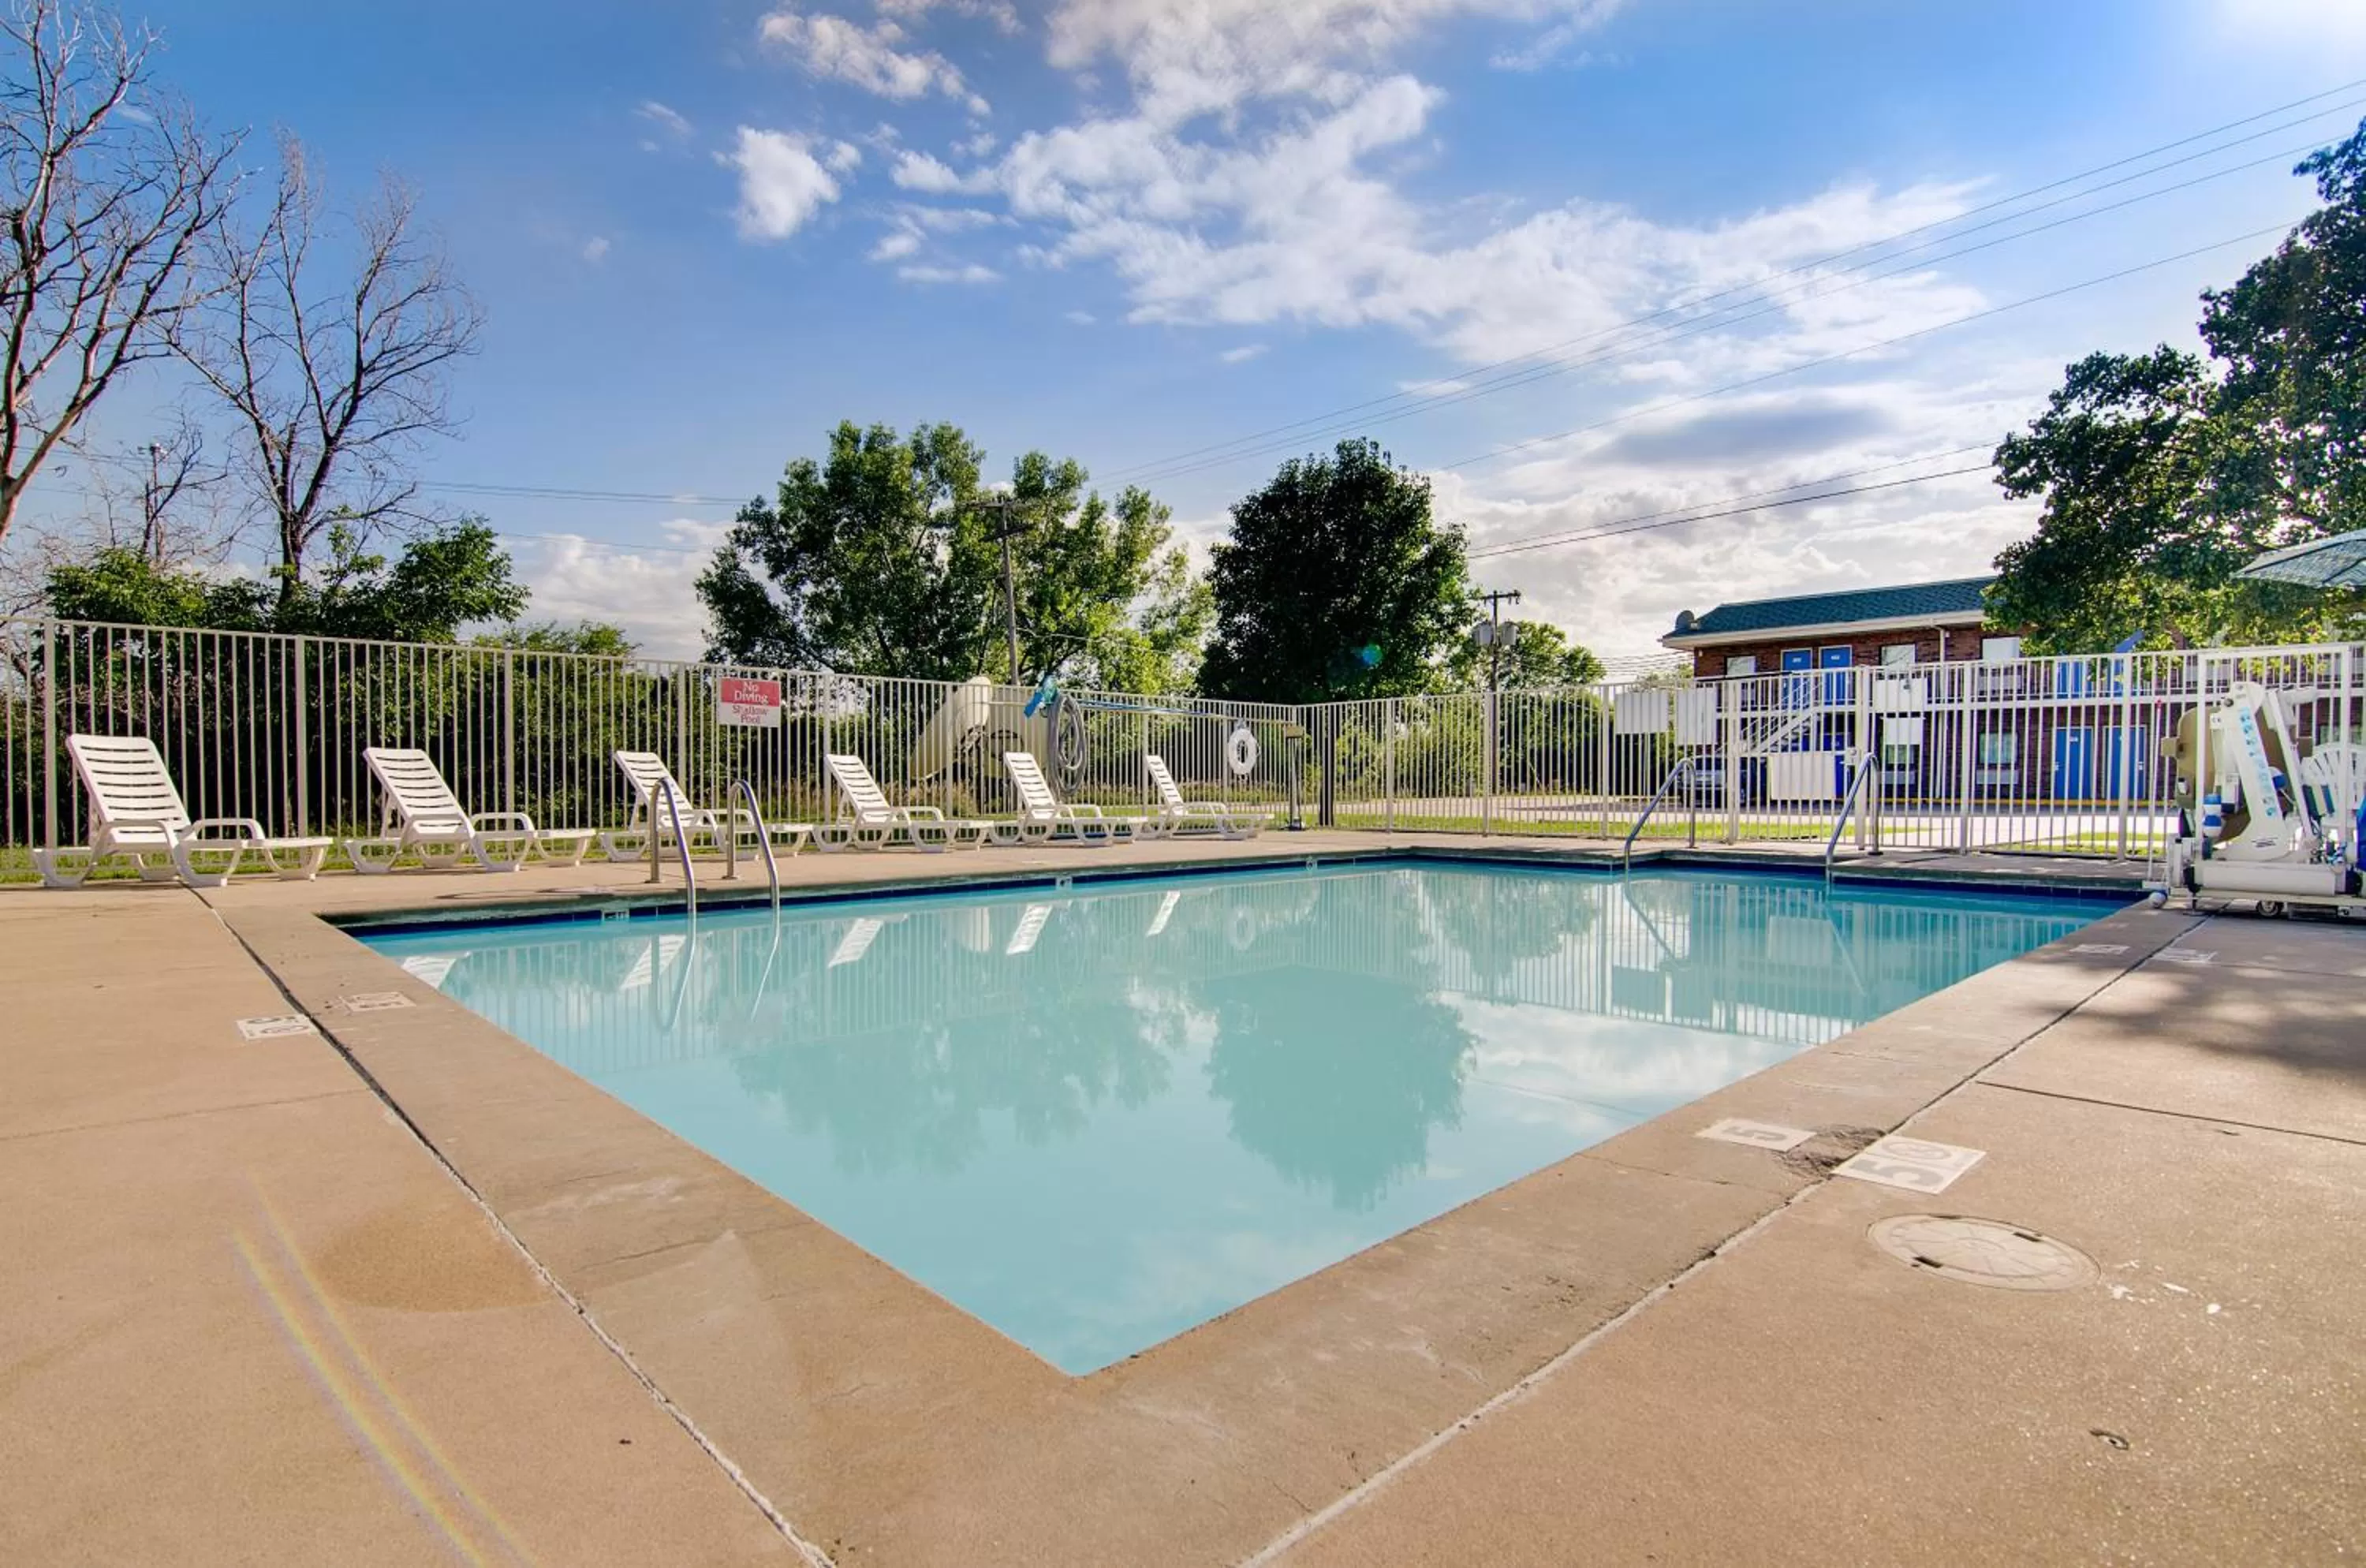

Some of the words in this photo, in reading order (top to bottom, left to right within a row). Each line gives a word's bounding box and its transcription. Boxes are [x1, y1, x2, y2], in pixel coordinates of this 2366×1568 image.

[743, 681, 759, 693] No
[734, 690, 769, 704] Diving
[741, 714, 761, 724] Pool
[1722, 1126, 1788, 1141] 5
[1849, 1159, 1945, 1187] 5
